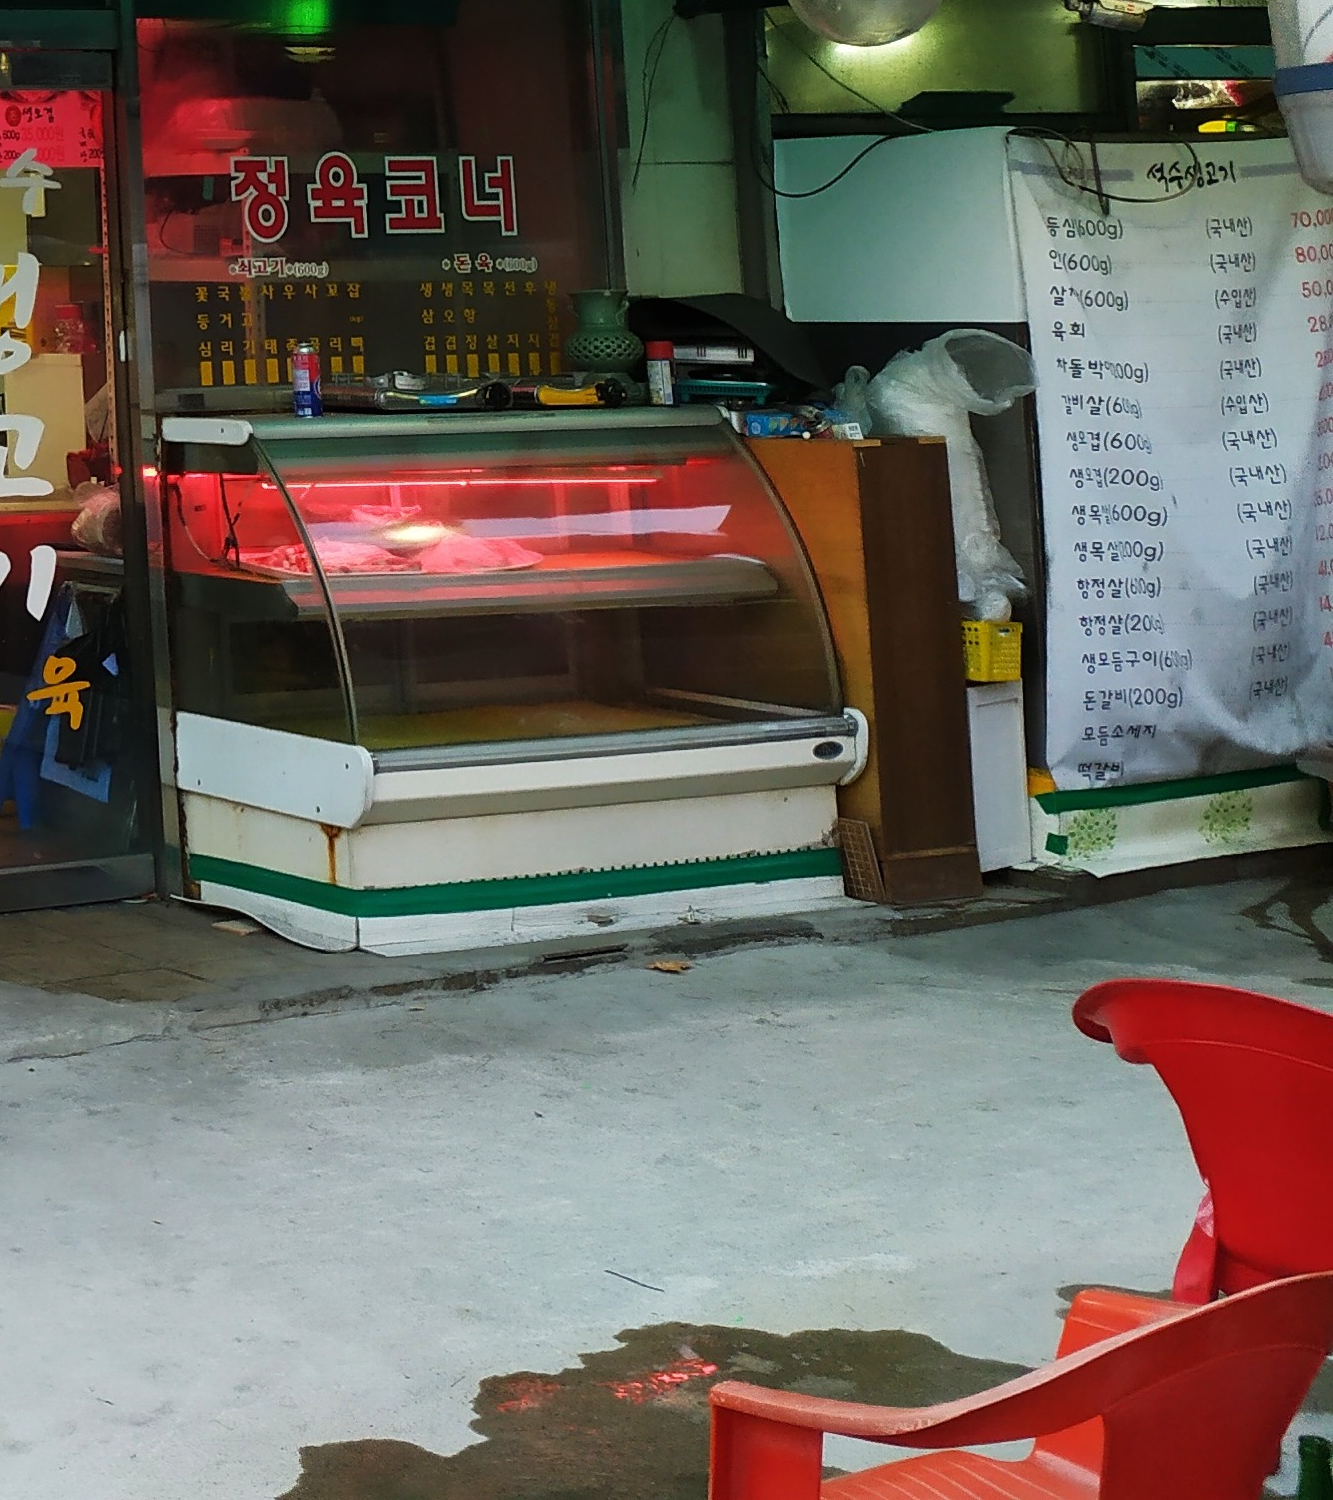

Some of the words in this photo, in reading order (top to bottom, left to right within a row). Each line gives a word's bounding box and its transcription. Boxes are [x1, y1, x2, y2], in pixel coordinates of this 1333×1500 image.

[1147, 160, 1236, 192] 석수생고기
[230, 151, 518, 243] 정육코너
[1206, 217, 1253, 238] (국내산)
[238, 257, 287, 279] 쇠고기
[1210, 253, 1255, 274] (국내산)
[1215, 287, 1256, 309] (수입산)
[1051, 320, 1085, 341] 육회
[1218, 323, 1257, 344] (국내산)
[1220, 357, 1261, 379] (국내산)
[1221, 393, 1269, 416] (수입산)
[1222, 428, 1278, 451] (국내산)
[1230, 464, 1287, 488] (국내산)
[1237, 499, 1292, 523] (국내산)
[1246, 535, 1293, 559] (국내산)
[1254, 571, 1293, 595] (국내산)
[1083, 687, 1183, 711] 돈갈비(200g)
[1081, 725, 1157, 747] 모듬소세지
